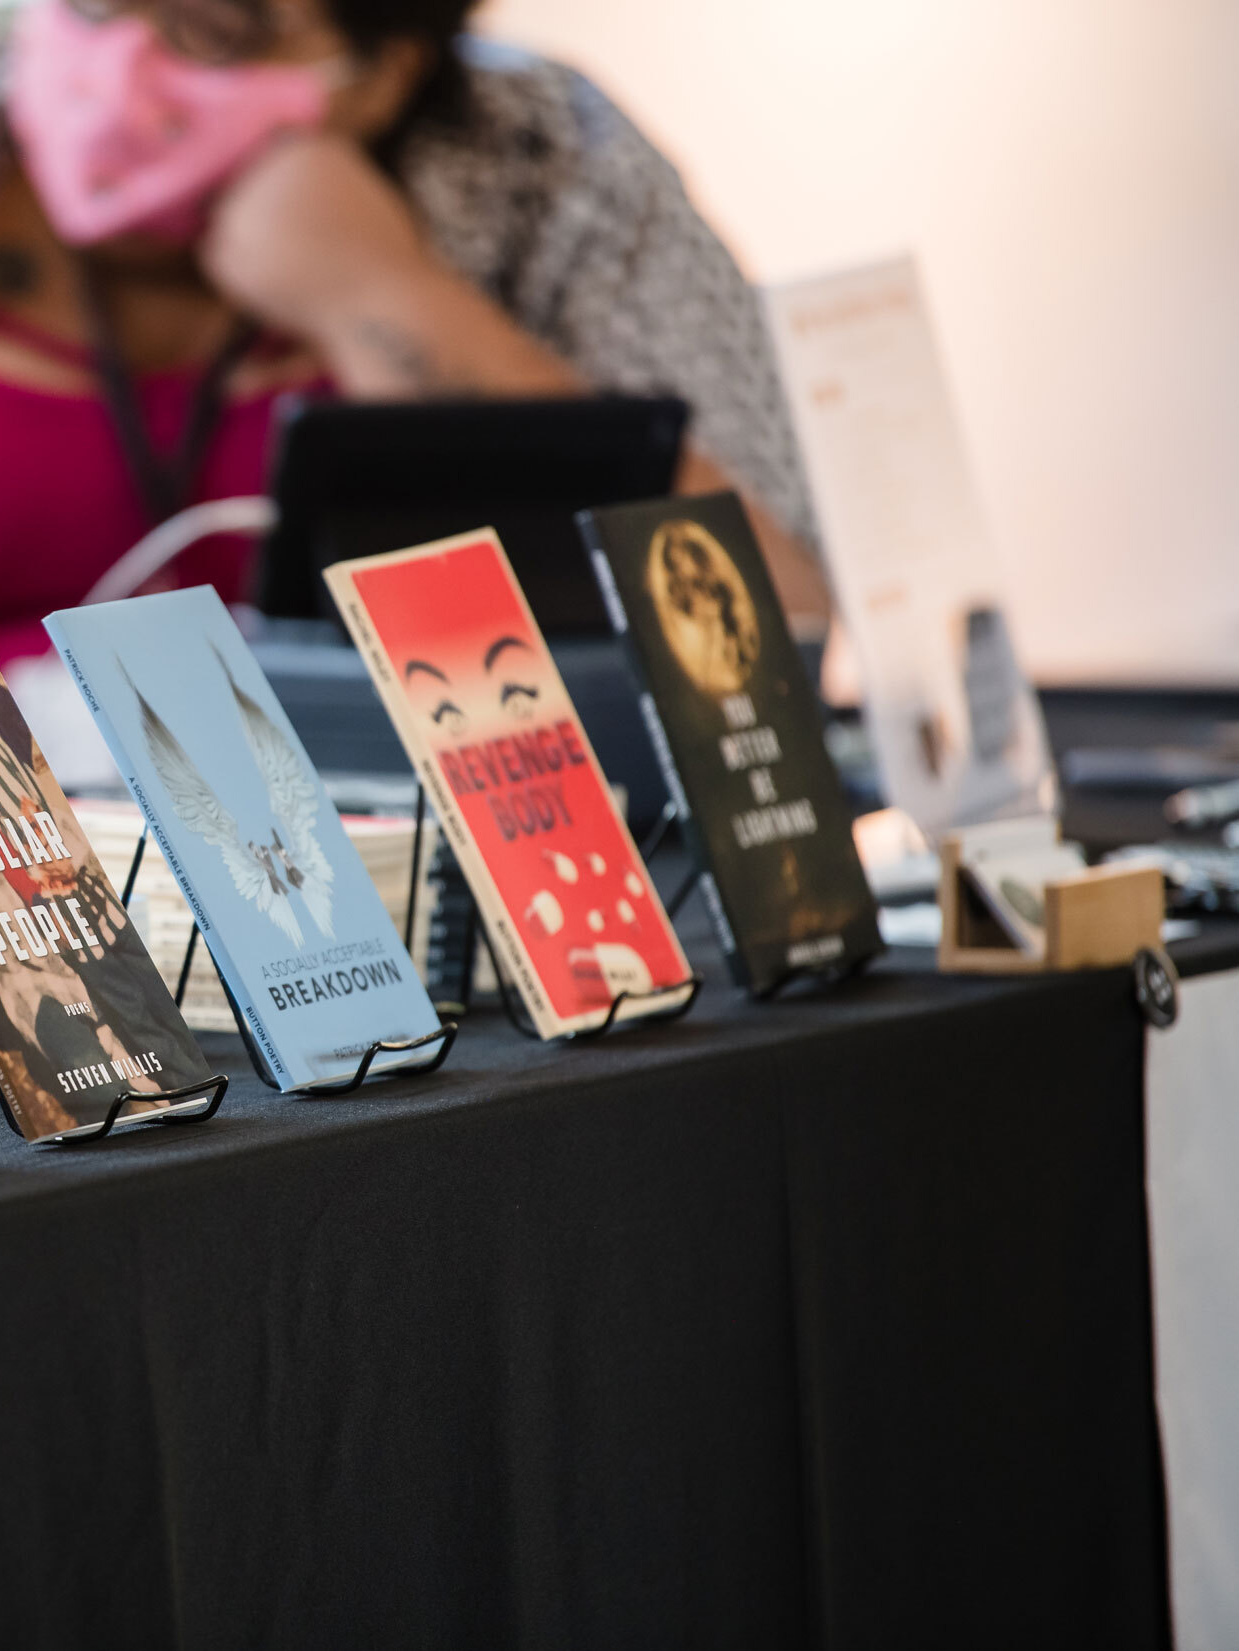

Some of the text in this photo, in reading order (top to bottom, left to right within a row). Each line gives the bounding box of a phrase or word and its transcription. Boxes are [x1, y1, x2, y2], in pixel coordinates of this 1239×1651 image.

[65, 649, 100, 713] PATRICK ROCHE
[439, 719, 586, 794] REVENGE
[489, 784, 573, 842] BODY
[133, 784, 155, 823] SOCIALLY
[153, 825, 183, 876] ACCEPTABLE
[180, 877, 211, 931] BREAKDOWN
[261, 938, 386, 980] A SOCIALLY ACCEPTABLE
[268, 958, 402, 1011] BREAKDOWN
[64, 1001, 91, 1017] POEMS
[246, 1007, 285, 1074] BUTTON POETRY
[4, 1084, 23, 1116] POETRY
[57, 1051, 163, 1094] STEVEN WILLIS
